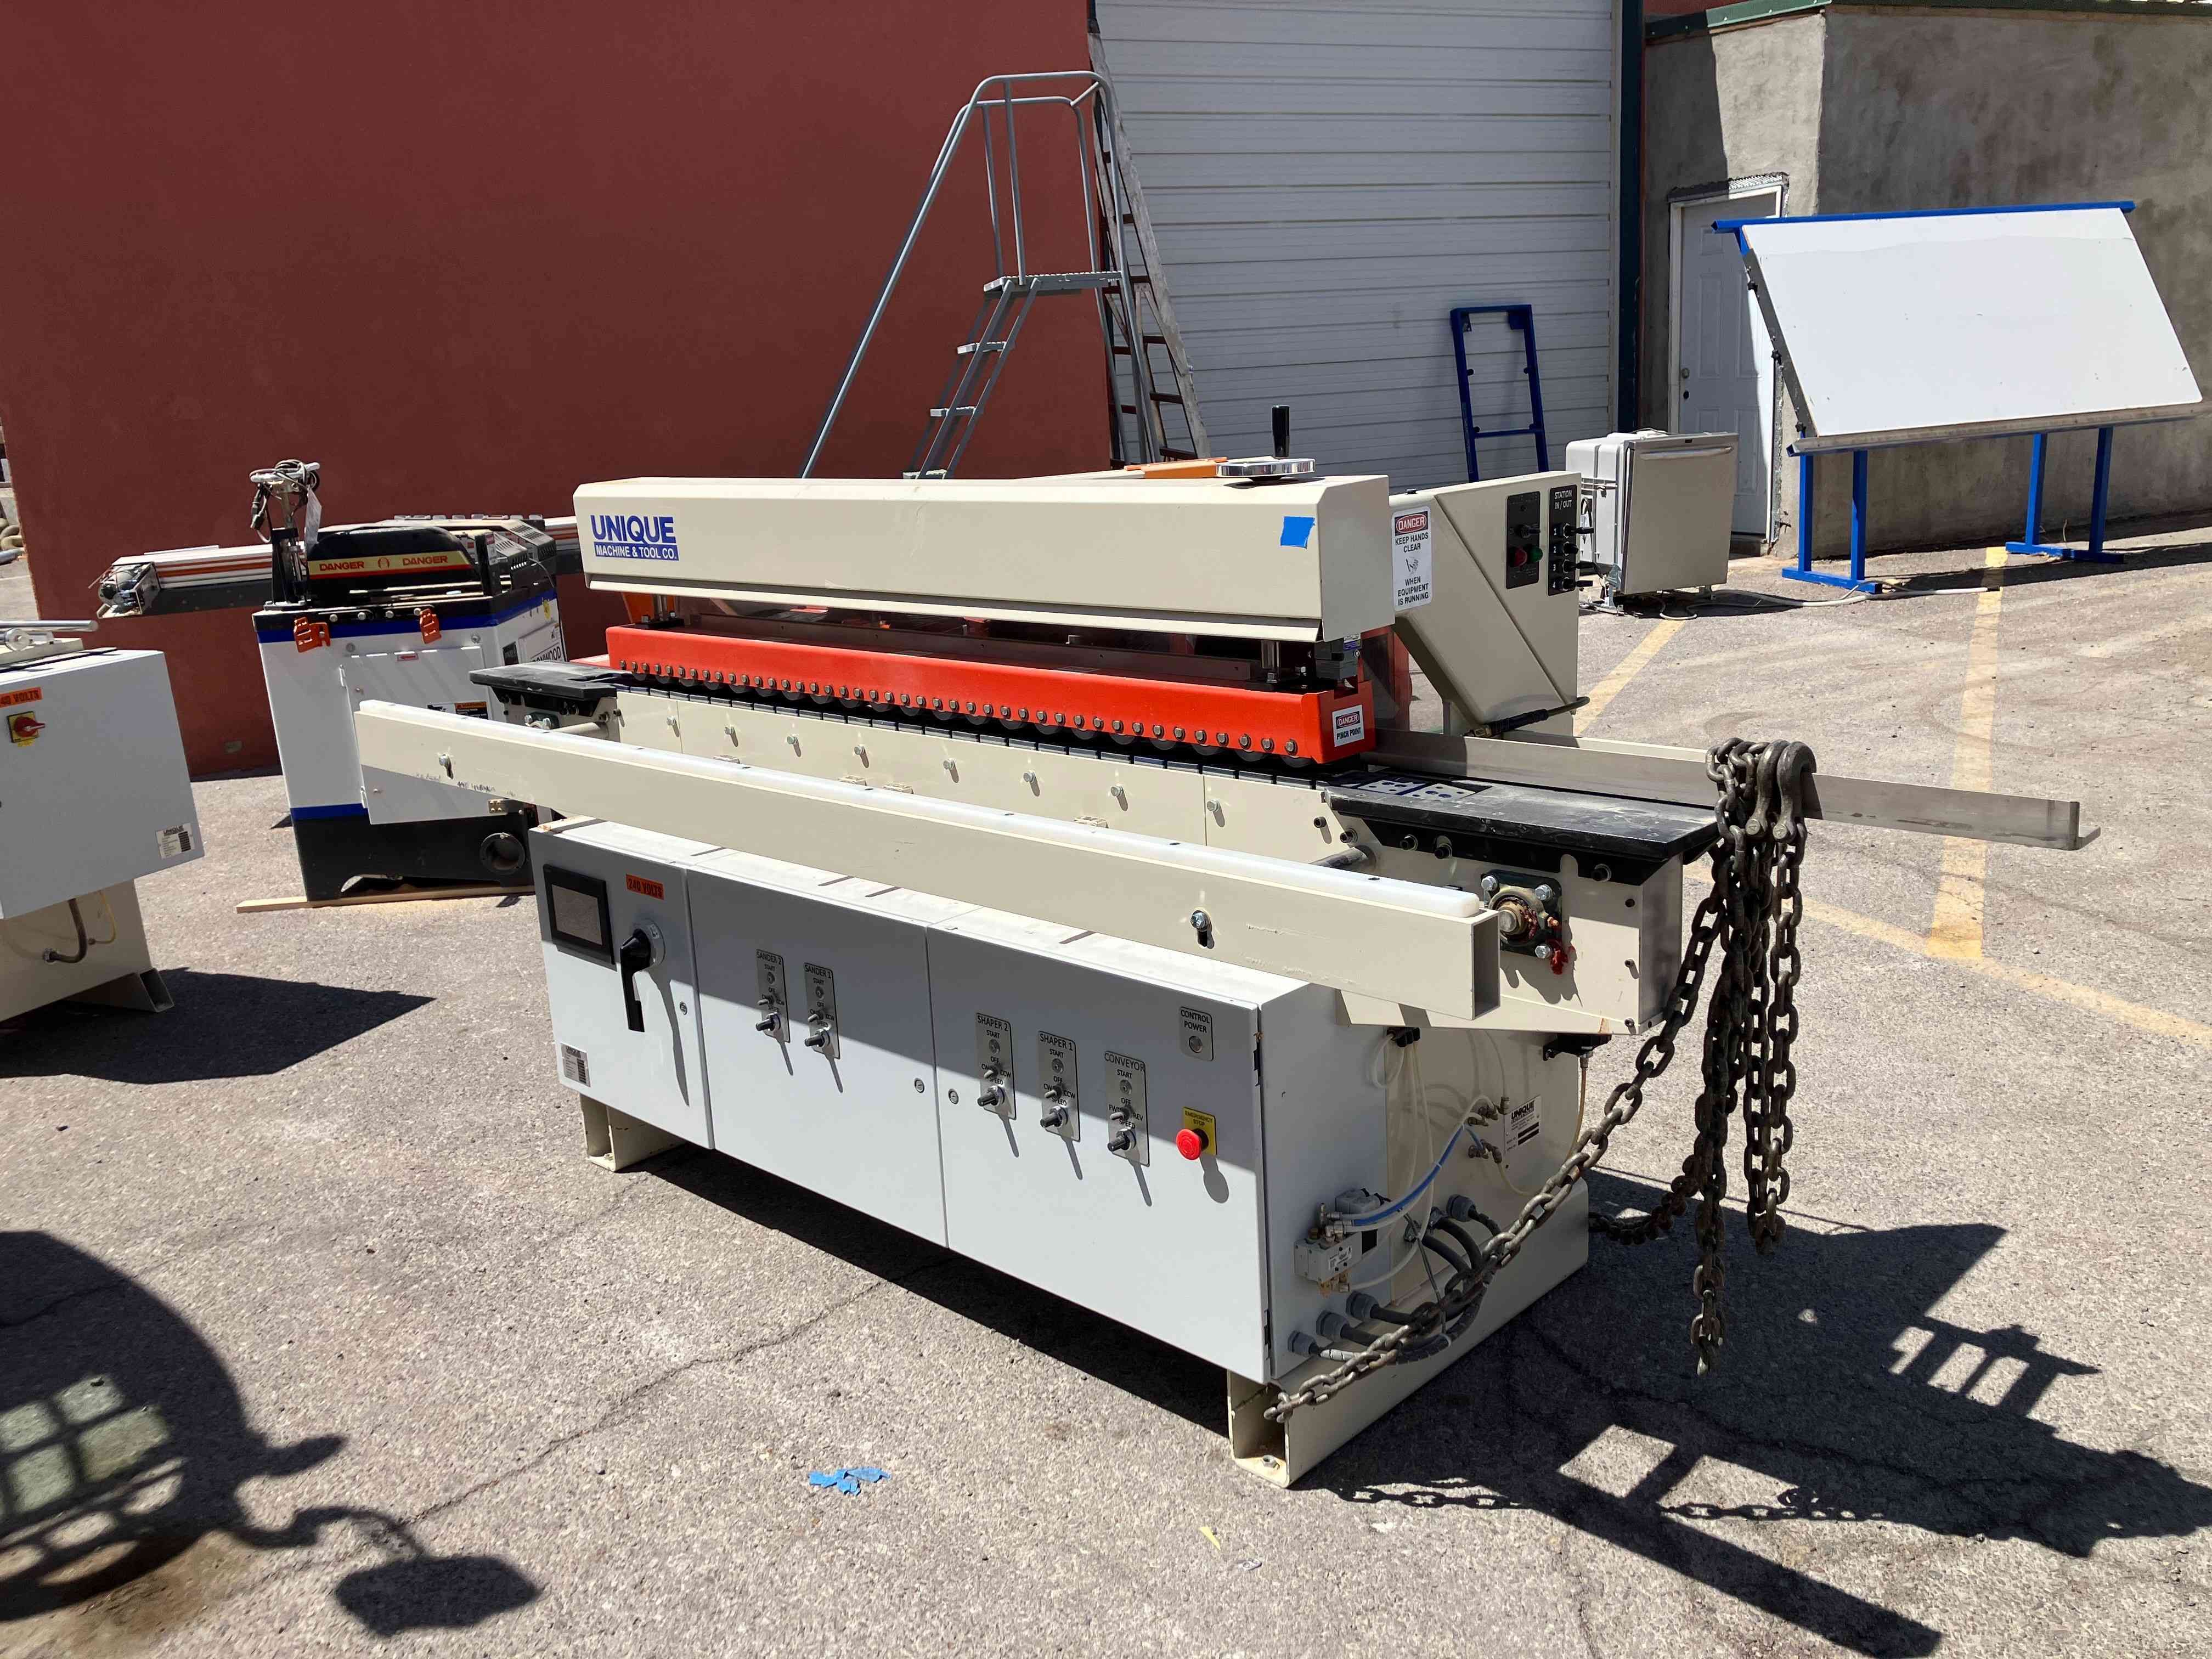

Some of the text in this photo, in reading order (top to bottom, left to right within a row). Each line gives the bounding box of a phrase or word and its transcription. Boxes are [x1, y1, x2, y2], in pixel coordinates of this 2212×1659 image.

[1555, 490, 1572, 499] STATION
[590, 515, 676, 544] UNIQUE
[1398, 517, 1425, 531] DANGER
[1395, 532, 1429, 545] KEEP HANDS
[596, 545, 677, 559] MACHINE & TOOL CO.
[1403, 543, 1420, 553] CLEAR
[319, 555, 448, 571] DANGER DANGER
[1405, 576, 1421, 586] WHEN
[1398, 583, 1429, 597] EQUIPMENT
[1405, 592, 1429, 604] RUNNING
[13, 690, 38, 702] VOLTS
[1339, 715, 1357, 725] DANGER
[1336, 727, 1361, 740] PINCH POINT
[628, 878, 663, 898] 240 VOLTS
[756, 951, 777, 963] SANDER
[804, 965, 827, 977] SANDER
[1181, 1009, 1210, 1024] CONTROL
[977, 1015, 1008, 1031] SHAPER 2
[1184, 1021, 1207, 1034] POWER
[986, 1030, 1000, 1039] START
[1040, 1034, 1073, 1051] SHAPER 1
[1049, 1049, 1064, 1058] START
[1104, 1052, 1146, 1071] CONVEYOR
[1000, 1070, 1011, 1078] CCW
[1117, 1069, 1132, 1079] START
[1064, 1090, 1075, 1099] CCW
[1121, 1097, 1131, 1106] OFF
[1133, 1113, 1143, 1121] REV
[1184, 1110, 1213, 1124] EMERGENCY
